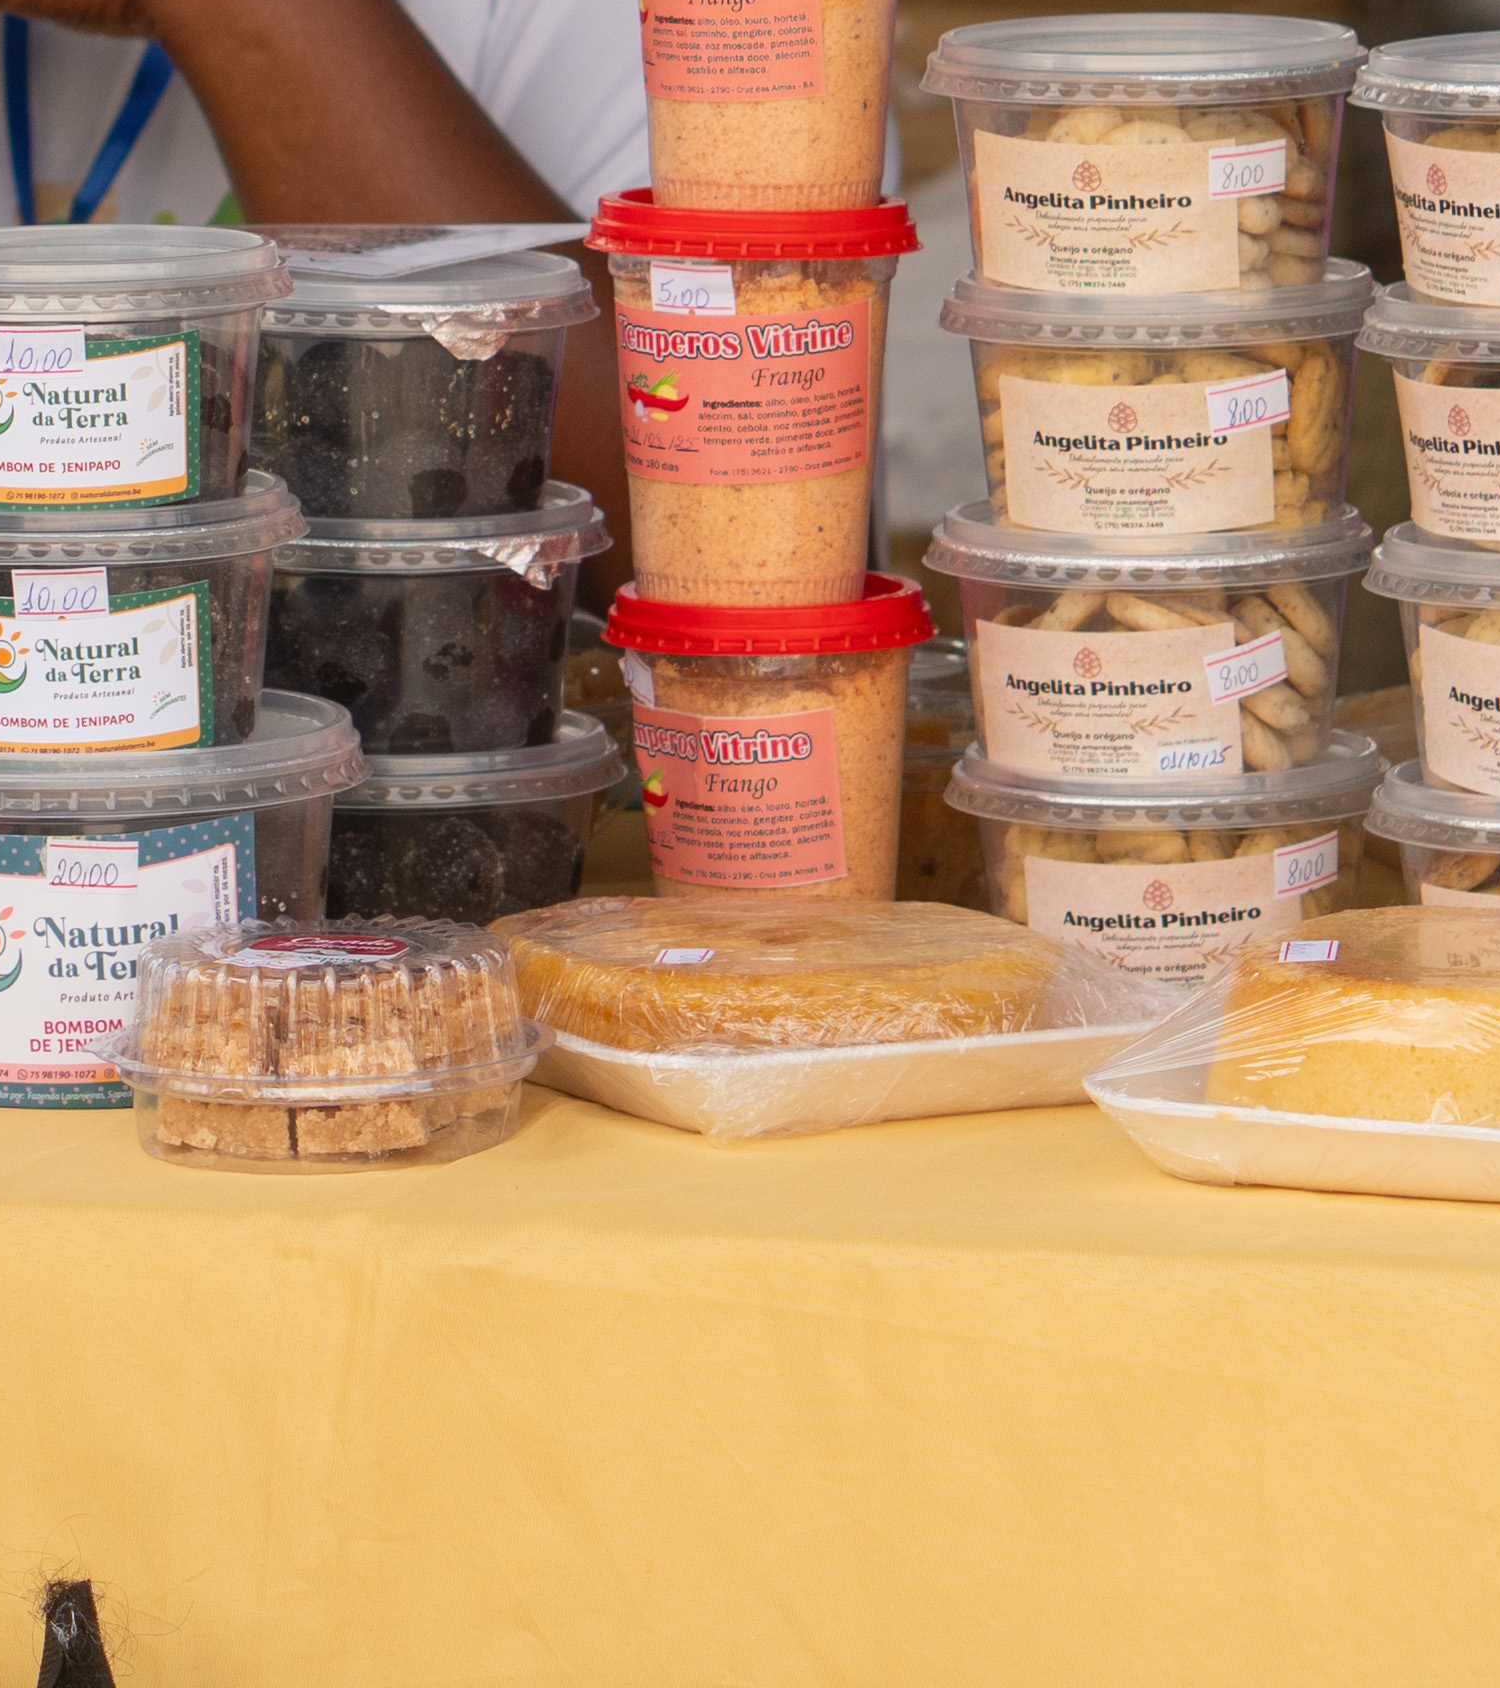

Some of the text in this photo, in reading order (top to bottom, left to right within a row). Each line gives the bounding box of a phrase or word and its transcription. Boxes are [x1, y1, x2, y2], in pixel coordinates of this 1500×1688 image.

[1222, 162, 1265, 191] 8,00
[1004, 187, 1192, 209] Angelita Pinheiro
[1051, 244, 1080, 255] Queijo
[658, 279, 711, 309] 5,00
[617, 314, 854, 362] Temperos Vitrine
[3, 338, 72, 372] 10,00
[751, 367, 826, 390] Frango
[22, 382, 127, 405] Natural
[32, 408, 128, 430] da Terra
[1228, 396, 1267, 427] 8,00
[40, 434, 122, 445] Produto Artesanal
[1033, 431, 1228, 452] Angelita Pinheiro
[39, 462, 56, 473] DE
[62, 460, 121, 474] JENIPAPO
[21, 582, 98, 612] 10,00
[35, 637, 140, 662] Natural
[45, 662, 142, 684] da Terra
[1006, 673, 1192, 696] Angelita Pinheiro
[1218, 662, 1259, 692] 8,00
[53, 688, 135, 700] Produto Artesanal
[53, 716, 69, 728] DE
[75, 714, 135, 729] JENIPAPO
[633, 721, 812, 765] mperos Vitrine
[704, 772, 778, 799] Frango
[50, 859, 119, 889] 20,00
[1286, 853, 1325, 887] 8,00
[33, 913, 179, 949] Natural
[1063, 907, 1261, 932] Angelita Pinheiro
[49, 951, 137, 981] da Ter
[60, 993, 110, 1004] Produto
[44, 1019, 123, 1035] BOMBOM
[30, 1039, 52, 1053] DE
[29, 1070, 96, 1080] 75 98190-1072
